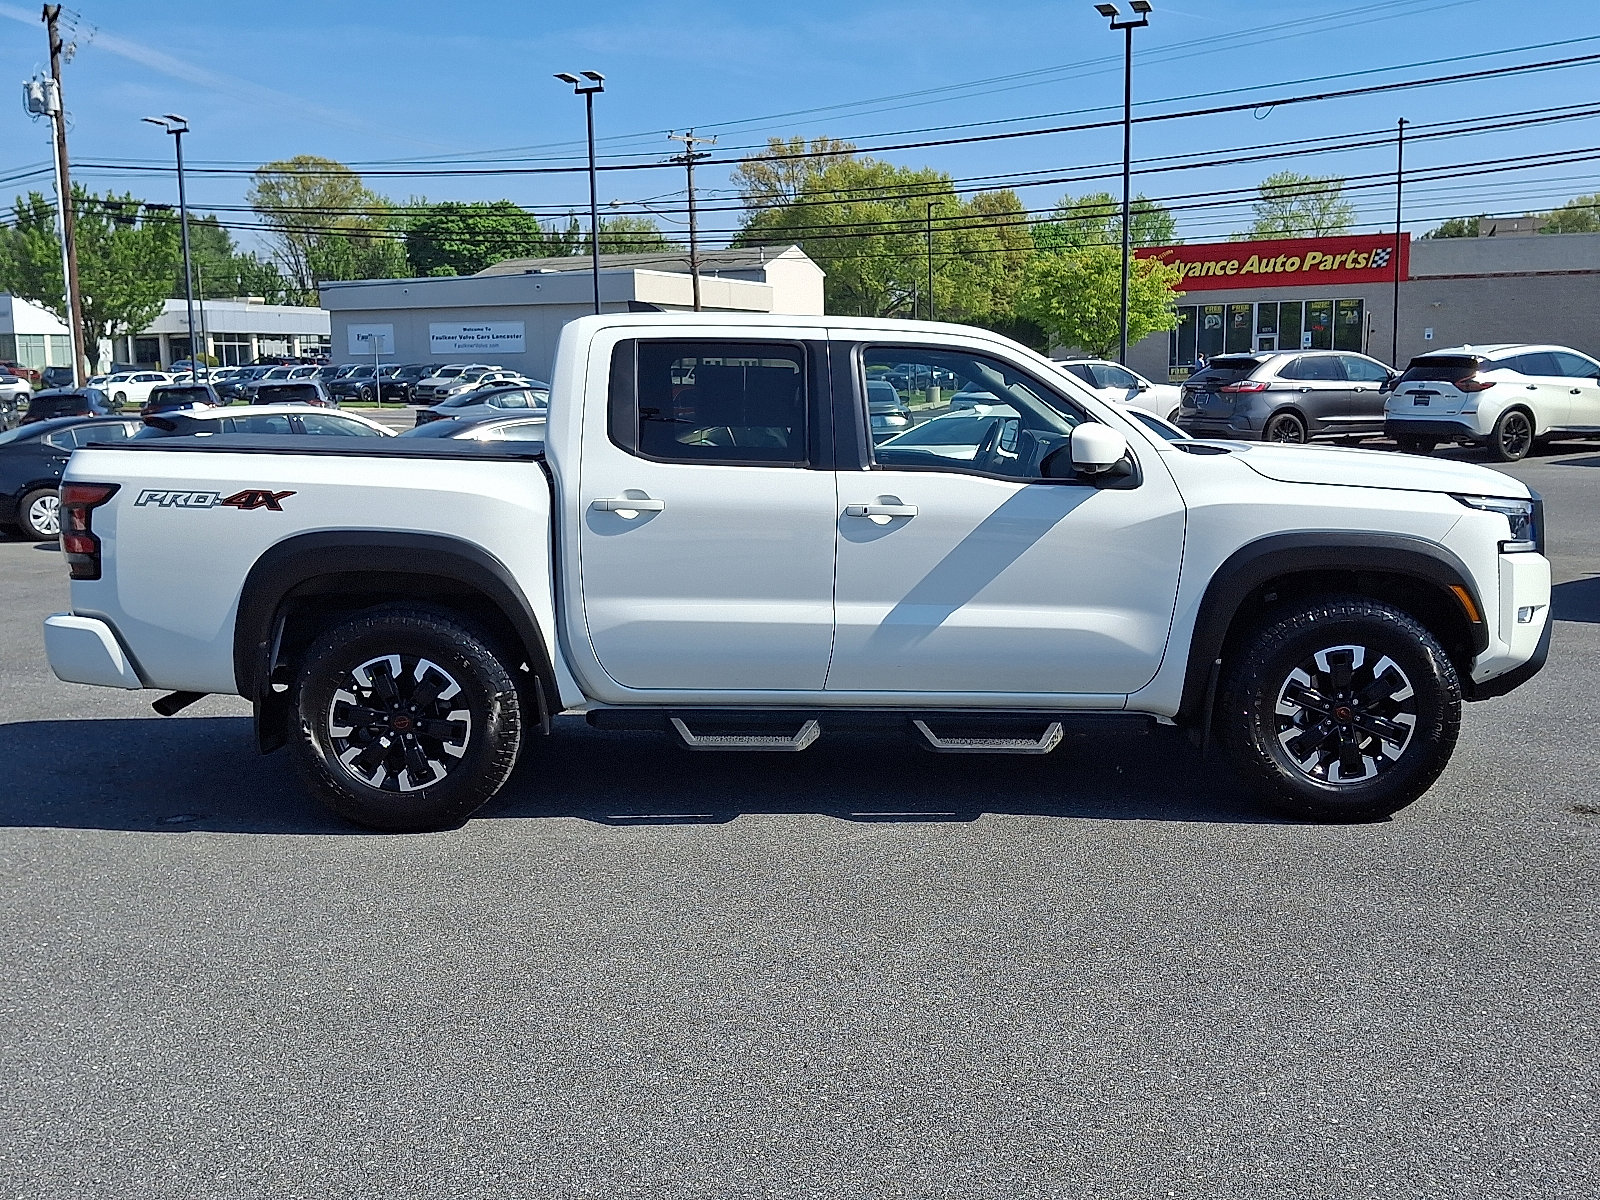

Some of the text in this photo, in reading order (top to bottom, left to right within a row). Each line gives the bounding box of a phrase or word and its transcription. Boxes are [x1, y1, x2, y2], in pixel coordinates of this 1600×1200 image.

[1150, 257, 1239, 278] dvance
[1240, 254, 1301, 275] Auto
[1302, 249, 1369, 271] Parts
[134, 489, 297, 512] PRO-4X
